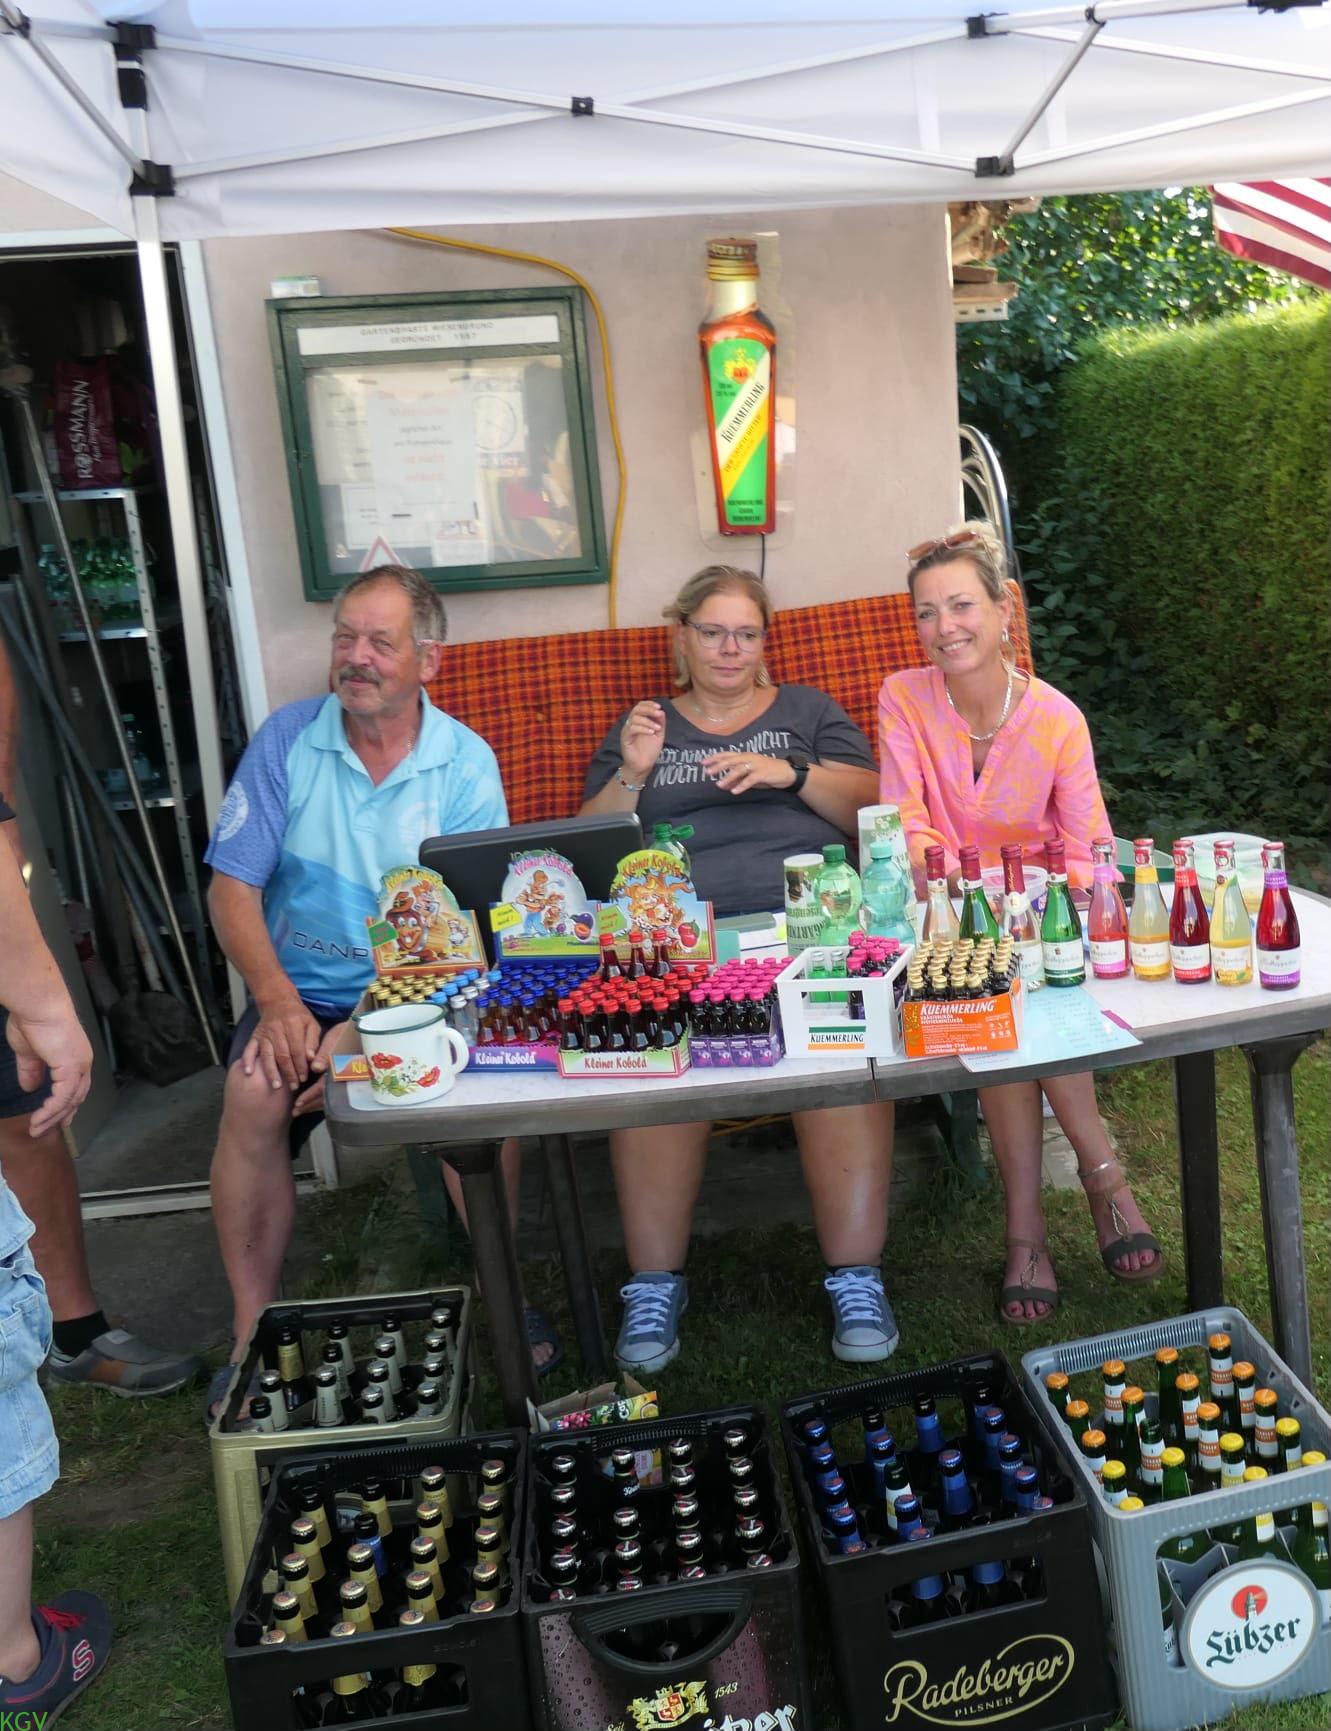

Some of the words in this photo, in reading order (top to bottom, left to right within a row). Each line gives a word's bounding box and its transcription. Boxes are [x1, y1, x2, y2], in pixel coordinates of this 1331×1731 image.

[69, 379, 96, 478] ROSSMANN
[919, 1002, 994, 1015] KUEMMERLING
[810, 1032, 865, 1044] KUEMMERLING
[475, 1052, 501, 1065] Kleiner
[503, 1051, 537, 1065] Kobold
[584, 1057, 614, 1070] Kleiner
[616, 1056, 648, 1069] Kobold
[1206, 1618, 1301, 1668] Lübzer
[714, 1681, 739, 1699] 1543
[885, 1648, 1064, 1722] Radeberger
[954, 1696, 1014, 1717] PILSNER
